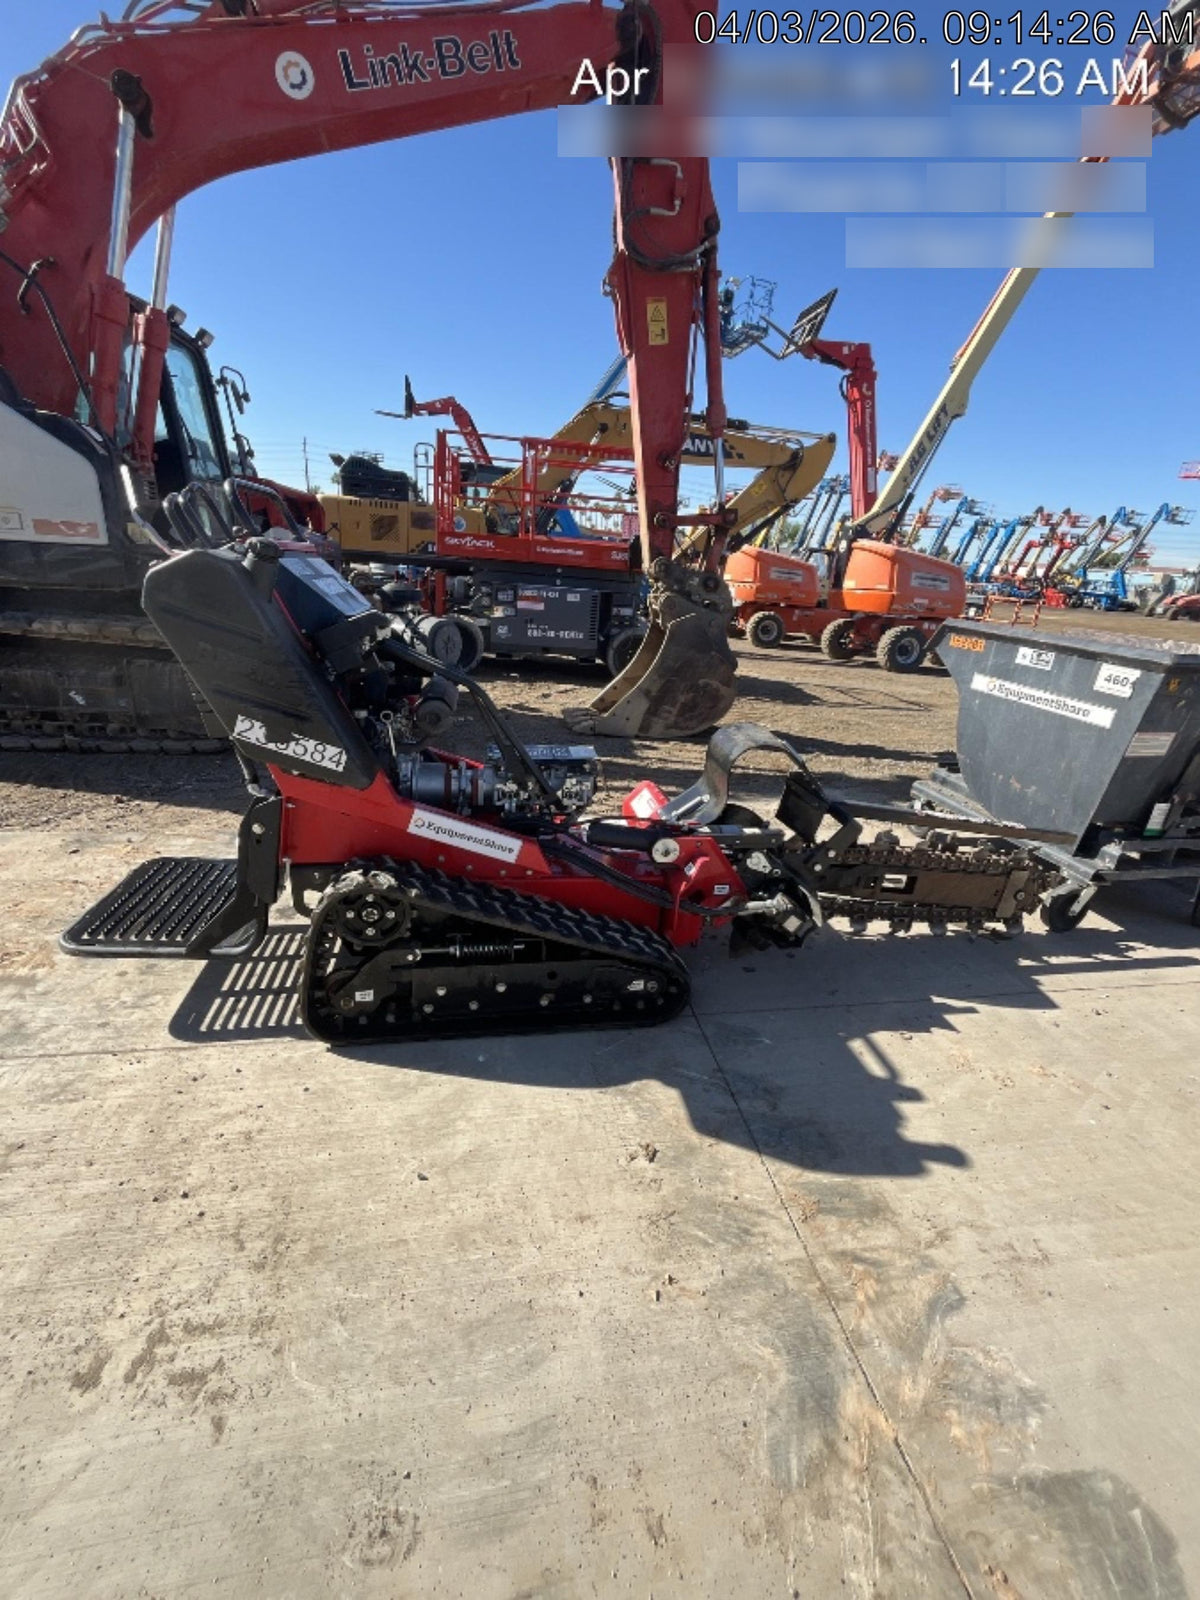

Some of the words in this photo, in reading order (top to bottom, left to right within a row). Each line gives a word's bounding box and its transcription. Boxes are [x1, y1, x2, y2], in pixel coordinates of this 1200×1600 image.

[338, 30, 521, 91] Link-Belt
[681, 437, 719, 454] ANY
[444, 536, 495, 548] SKYJACK
[996, 682, 1091, 718] EquipmentShare
[426, 820, 515, 854] EquipmentShare
